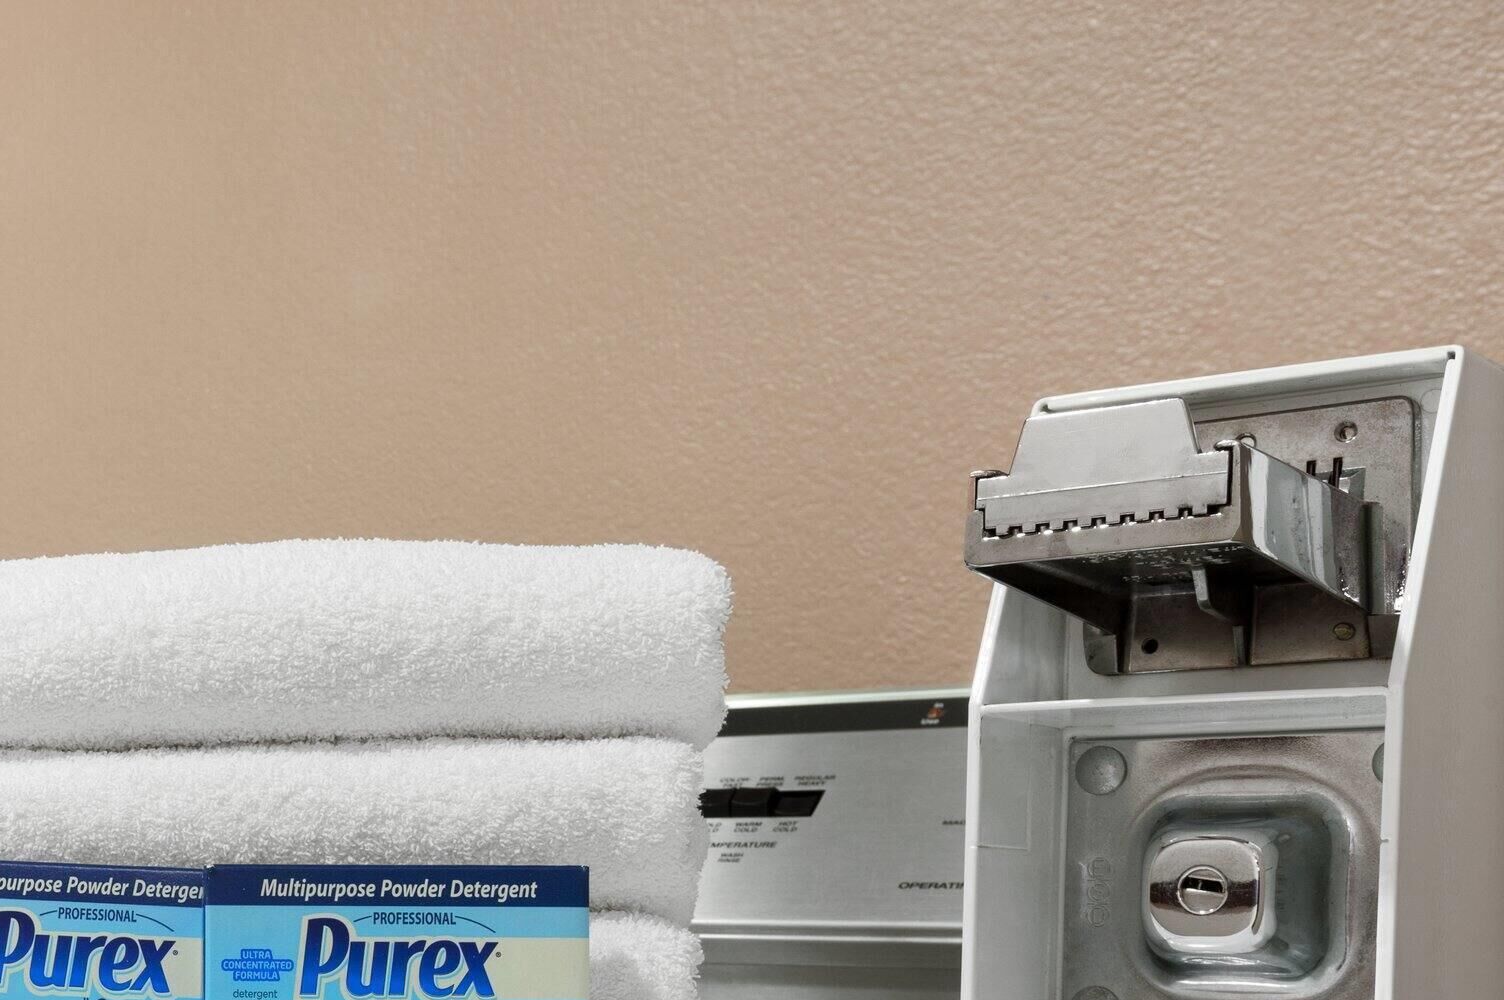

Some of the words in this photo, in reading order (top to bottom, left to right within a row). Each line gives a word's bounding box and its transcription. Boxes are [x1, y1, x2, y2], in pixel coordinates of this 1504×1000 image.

[710, 841, 777, 849] MPERATURE
[66, 875, 131, 897] Powder
[260, 878, 378, 902] Multipurpose
[380, 879, 447, 899] Powder
[449, 879, 538, 903] Detergent
[898, 881, 964, 890] OPERATI
[57, 906, 138, 923] PROFESSIONAL
[372, 911, 457, 926] PROFESSIONAL
[242, 950, 272, 960] ULTRA
[222, 960, 292, 970] CONCENTRATED
[235, 970, 279, 980] FORMULA
[232, 988, 278, 1000] detergent
